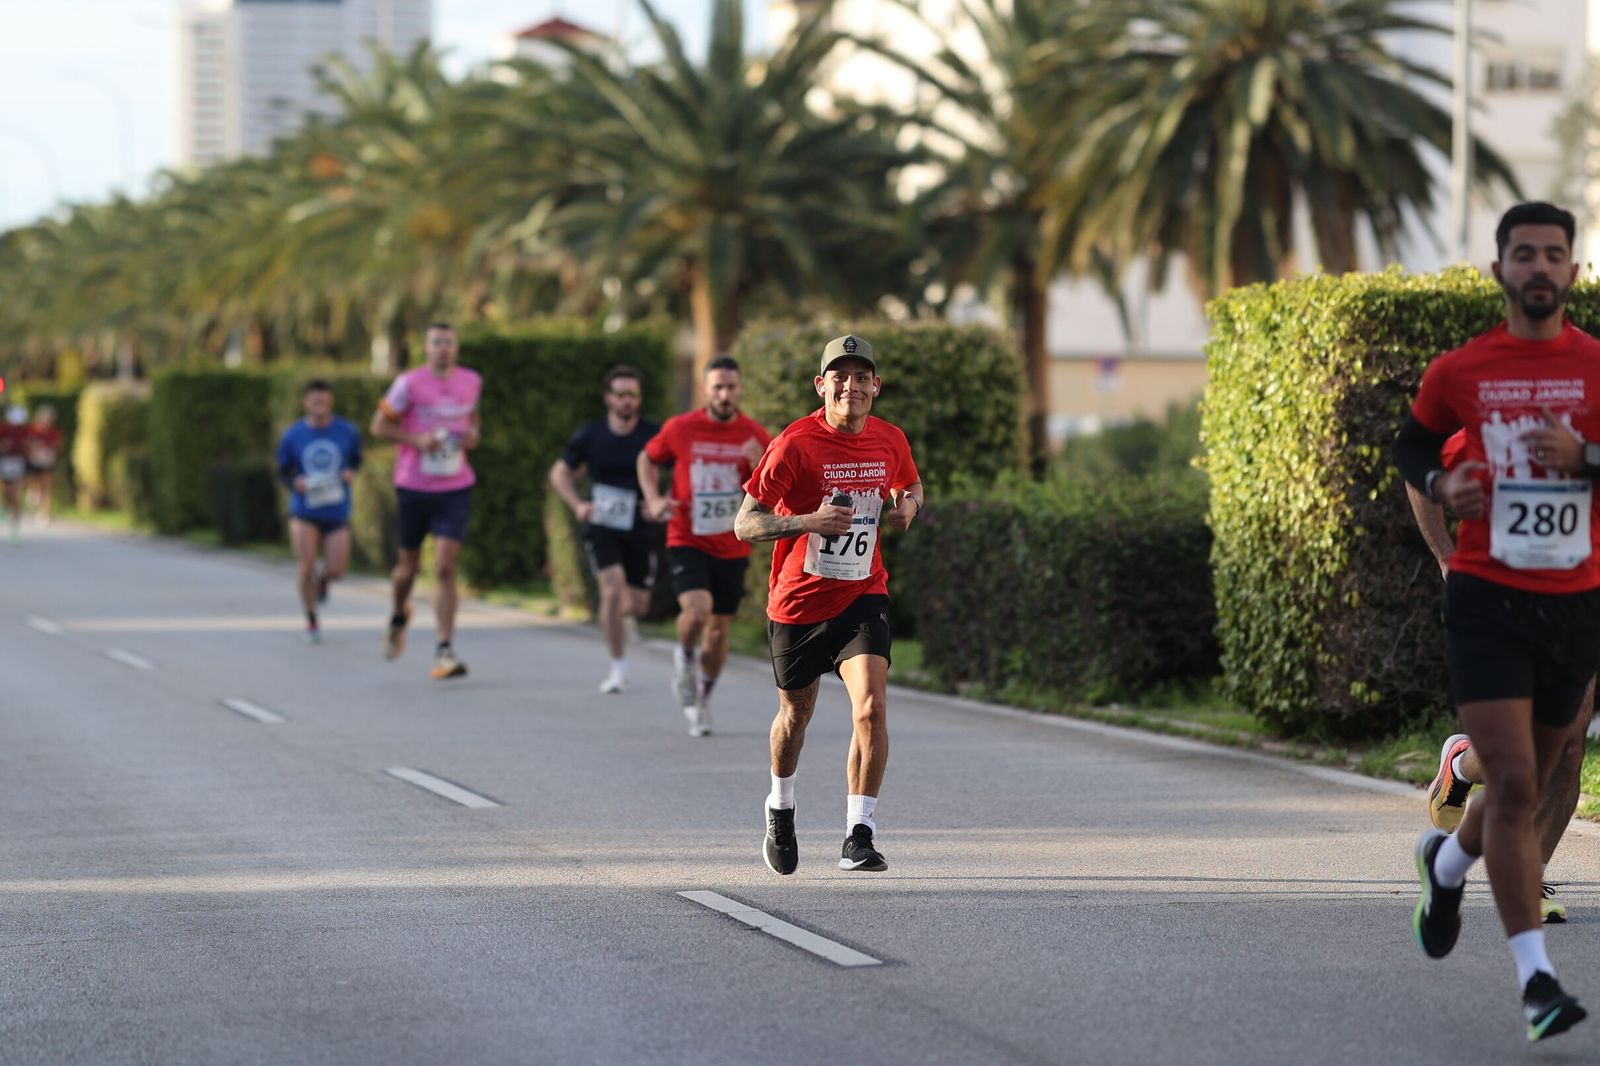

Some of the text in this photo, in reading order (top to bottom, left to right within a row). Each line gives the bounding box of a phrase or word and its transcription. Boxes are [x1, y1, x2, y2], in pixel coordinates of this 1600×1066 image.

[1478, 389, 1532, 401] CIUDAD
[824, 467, 886, 479] CIUDAD JARDÍN
[1508, 503, 1578, 537] 280
[819, 531, 868, 556] 176
